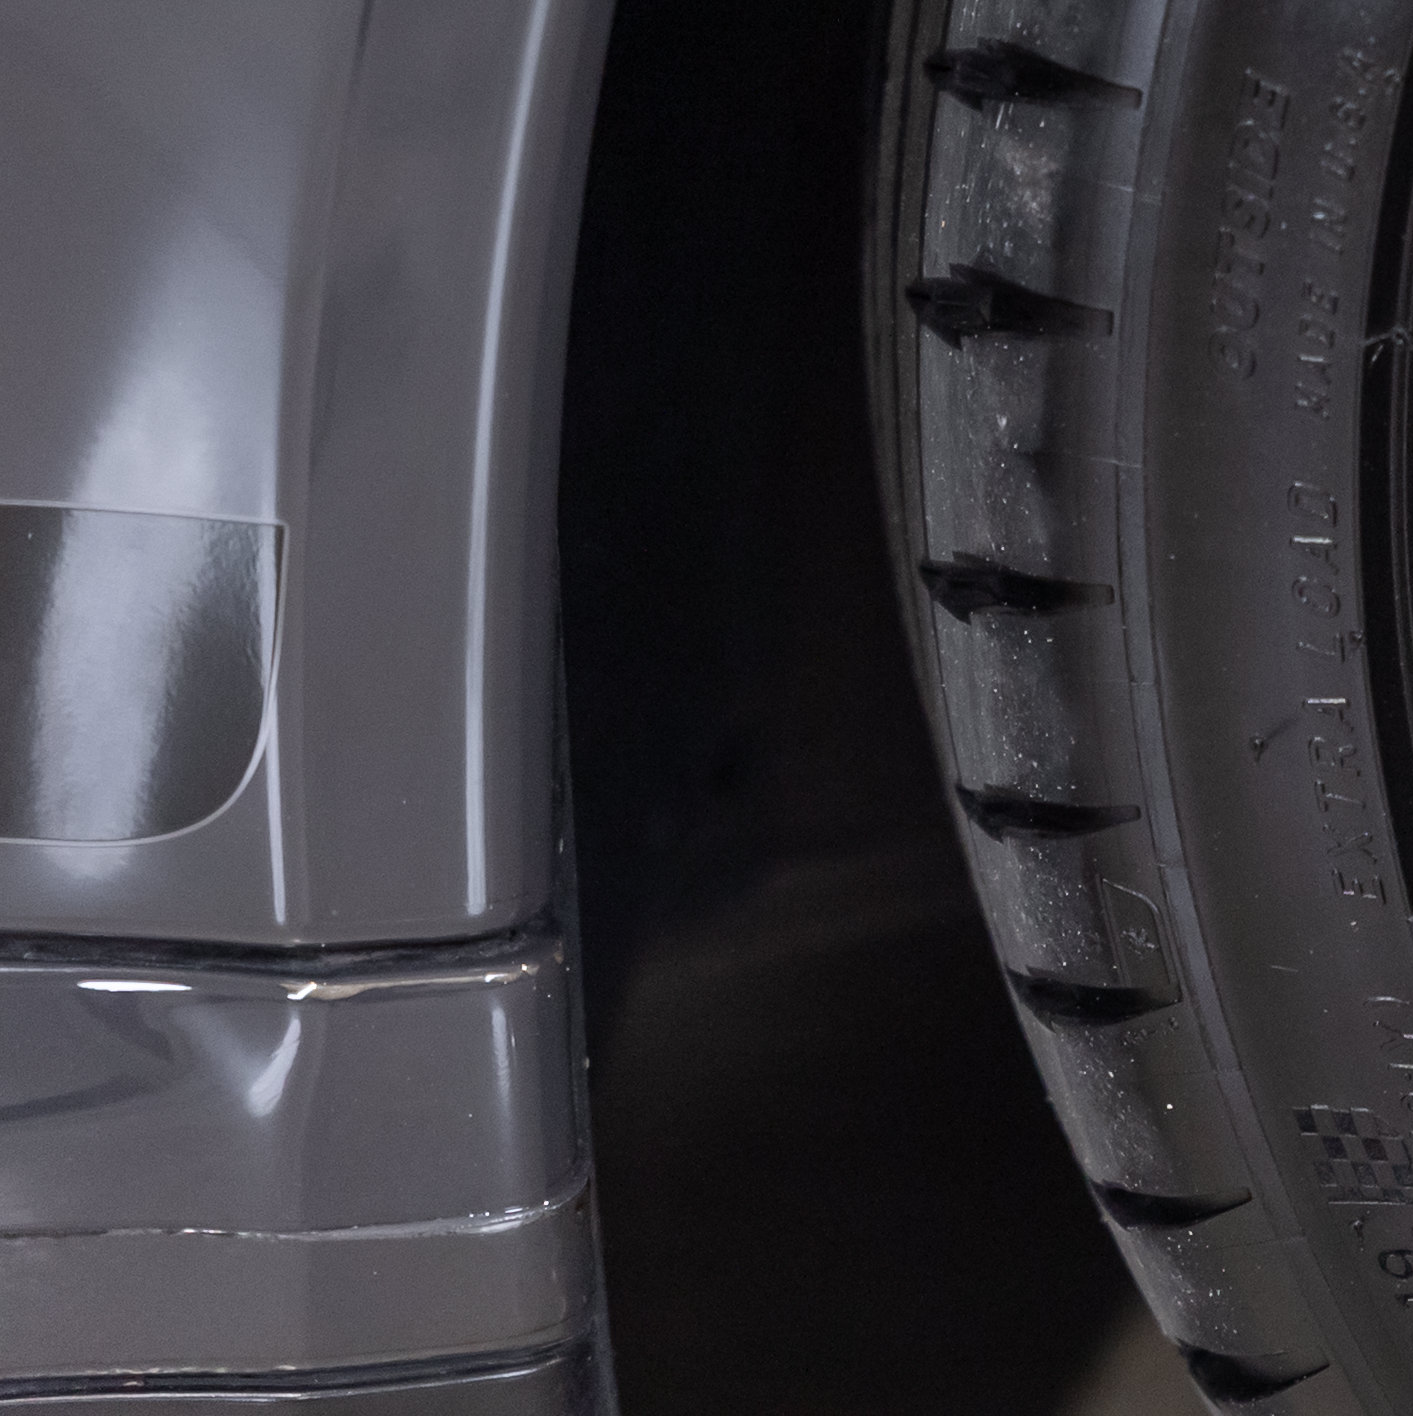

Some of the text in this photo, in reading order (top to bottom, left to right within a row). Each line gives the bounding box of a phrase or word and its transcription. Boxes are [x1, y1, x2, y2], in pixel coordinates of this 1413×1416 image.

[1210, 67, 1290, 379] OUTSIDE
[1286, 481, 1388, 907] EXTRA LOAD
